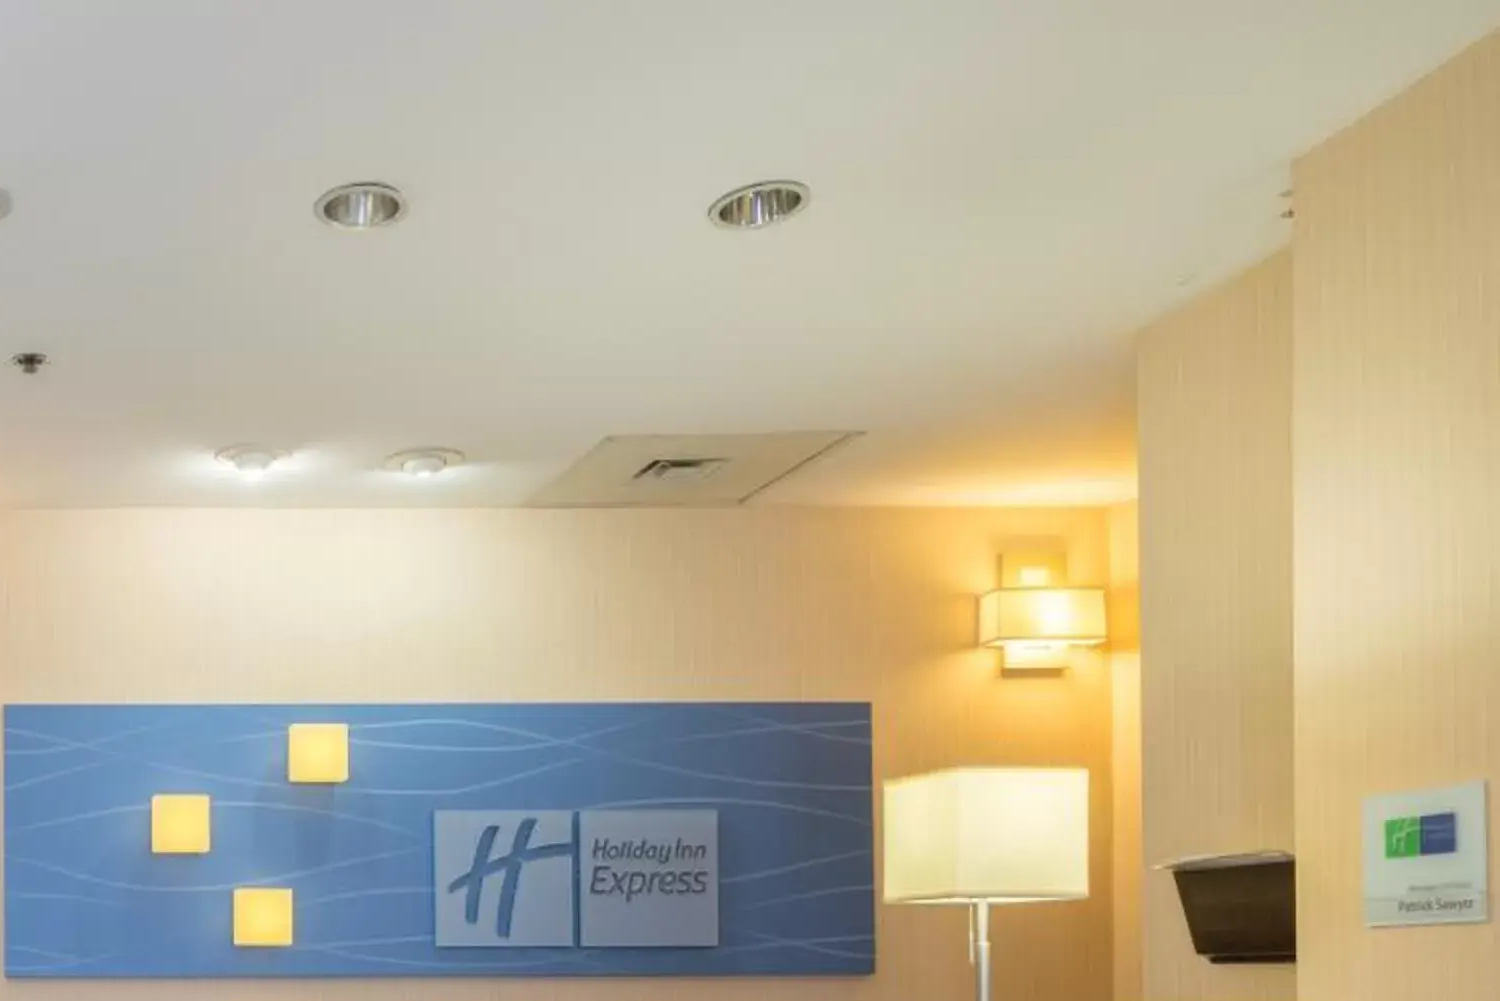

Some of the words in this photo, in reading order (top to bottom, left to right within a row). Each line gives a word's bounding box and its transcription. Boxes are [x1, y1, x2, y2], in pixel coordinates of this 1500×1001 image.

[591, 838, 671, 863] Holiday
[674, 837, 707, 860] Inn
[589, 865, 709, 902] Express
